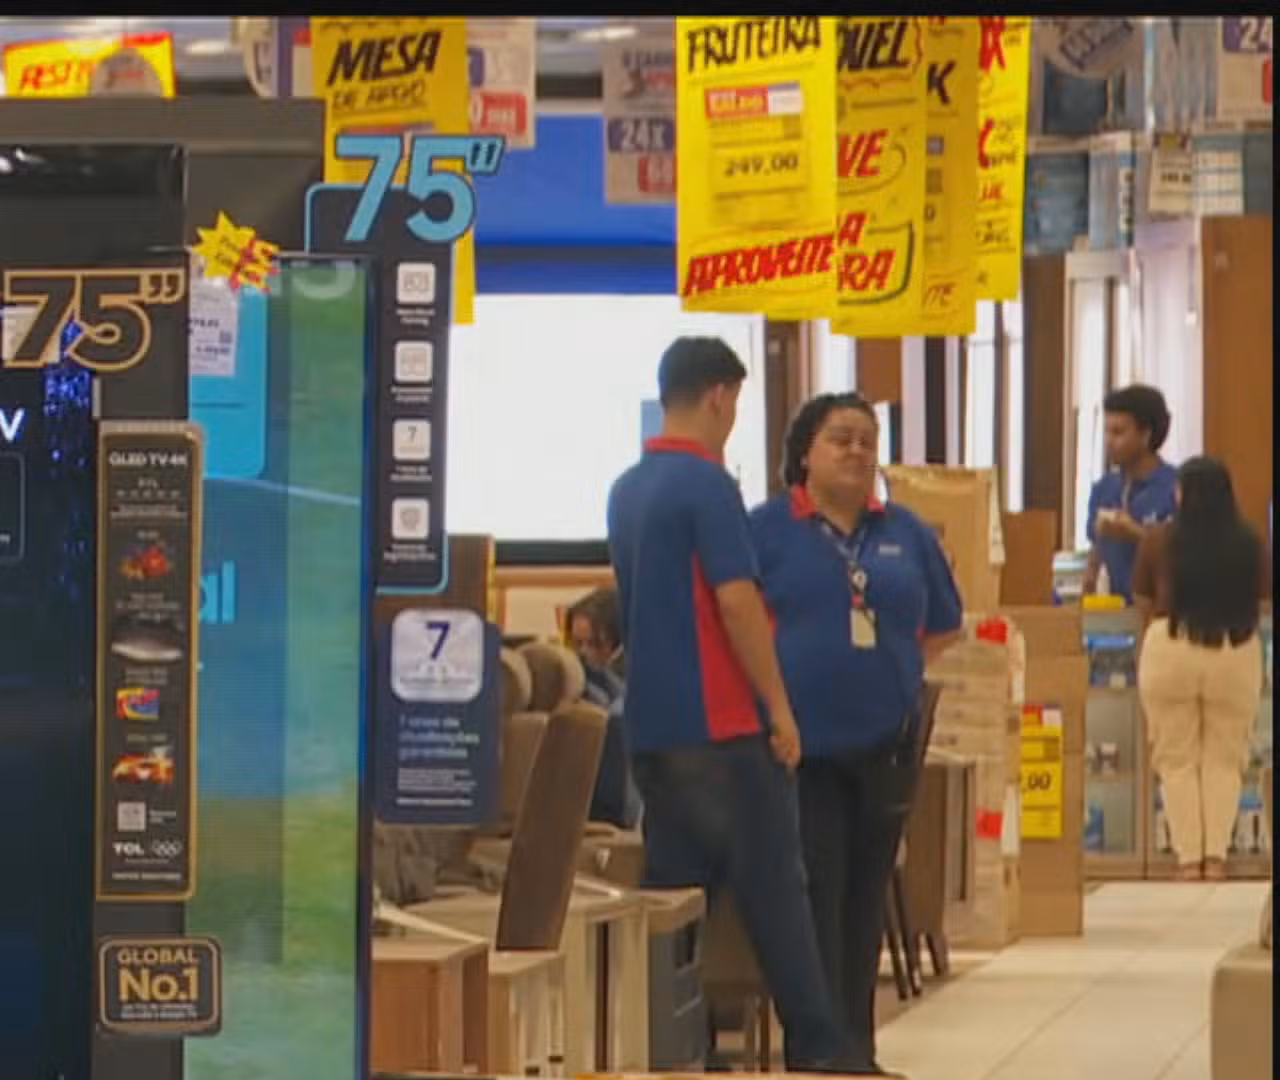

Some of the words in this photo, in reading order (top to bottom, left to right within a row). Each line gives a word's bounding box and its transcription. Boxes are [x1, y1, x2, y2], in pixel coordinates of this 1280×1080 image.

[326, 30, 443, 88] MESA
[426, 620, 450, 659] 7
[118, 950, 197, 965] GLOBAL
[119, 968, 198, 1001] No.1
